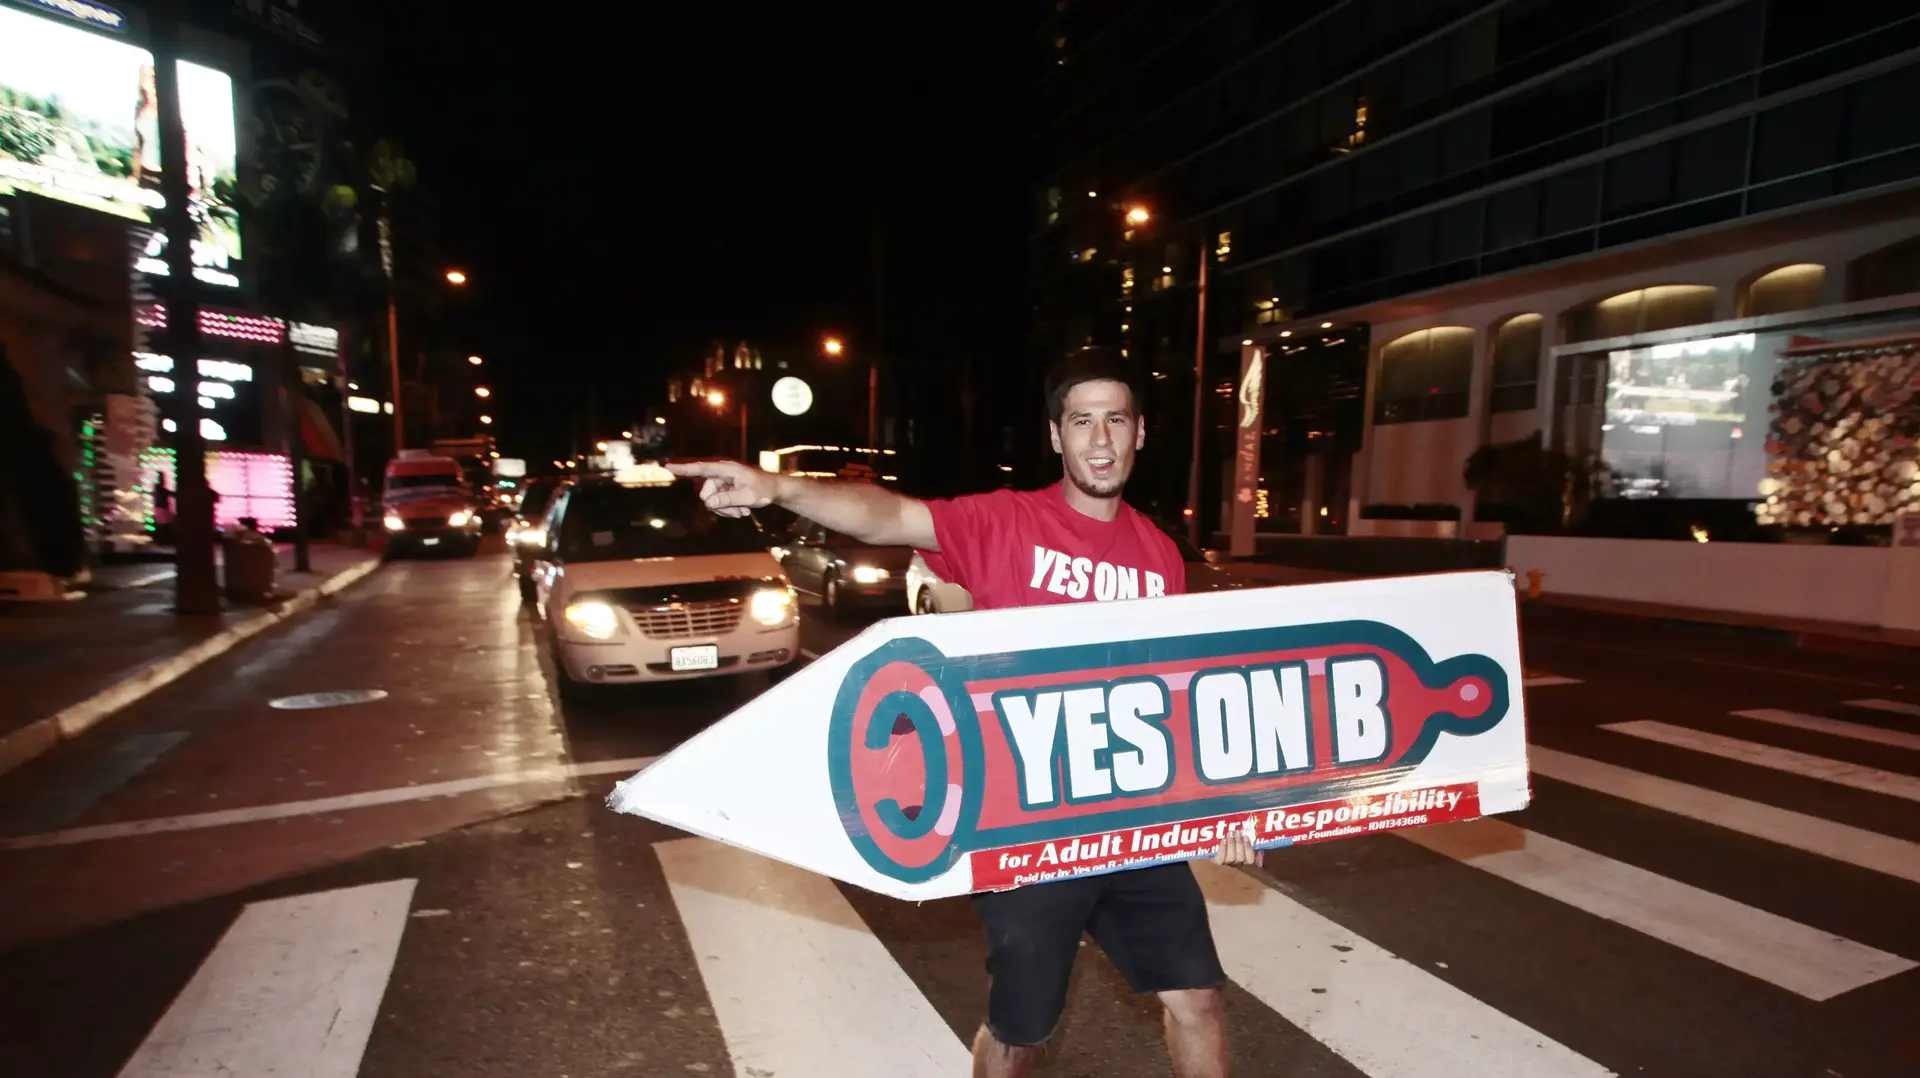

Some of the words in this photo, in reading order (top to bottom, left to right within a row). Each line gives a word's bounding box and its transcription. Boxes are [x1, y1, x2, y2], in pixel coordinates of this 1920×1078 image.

[1030, 545, 1093, 599] YES
[1094, 561, 1139, 601] ON
[1145, 570, 1165, 598] B
[1000, 681, 1169, 805] YES
[1196, 666, 1309, 780] ON
[1331, 659, 1388, 763] B
[999, 853, 1032, 870] for
[1035, 835, 1124, 867] Adult
[1131, 819, 1256, 852] Industr
[1265, 789, 1462, 833] Responsibility
[1014, 871, 1039, 885] Paid
[1040, 870, 1056, 881] for
[1057, 868, 1071, 878] by
[1072, 865, 1091, 875] Yes
[1092, 863, 1106, 872] on
[1155, 849, 1197, 861] Funding
[1308, 825, 1362, 840] Foundation
[1368, 814, 1428, 831] ID#1343686
